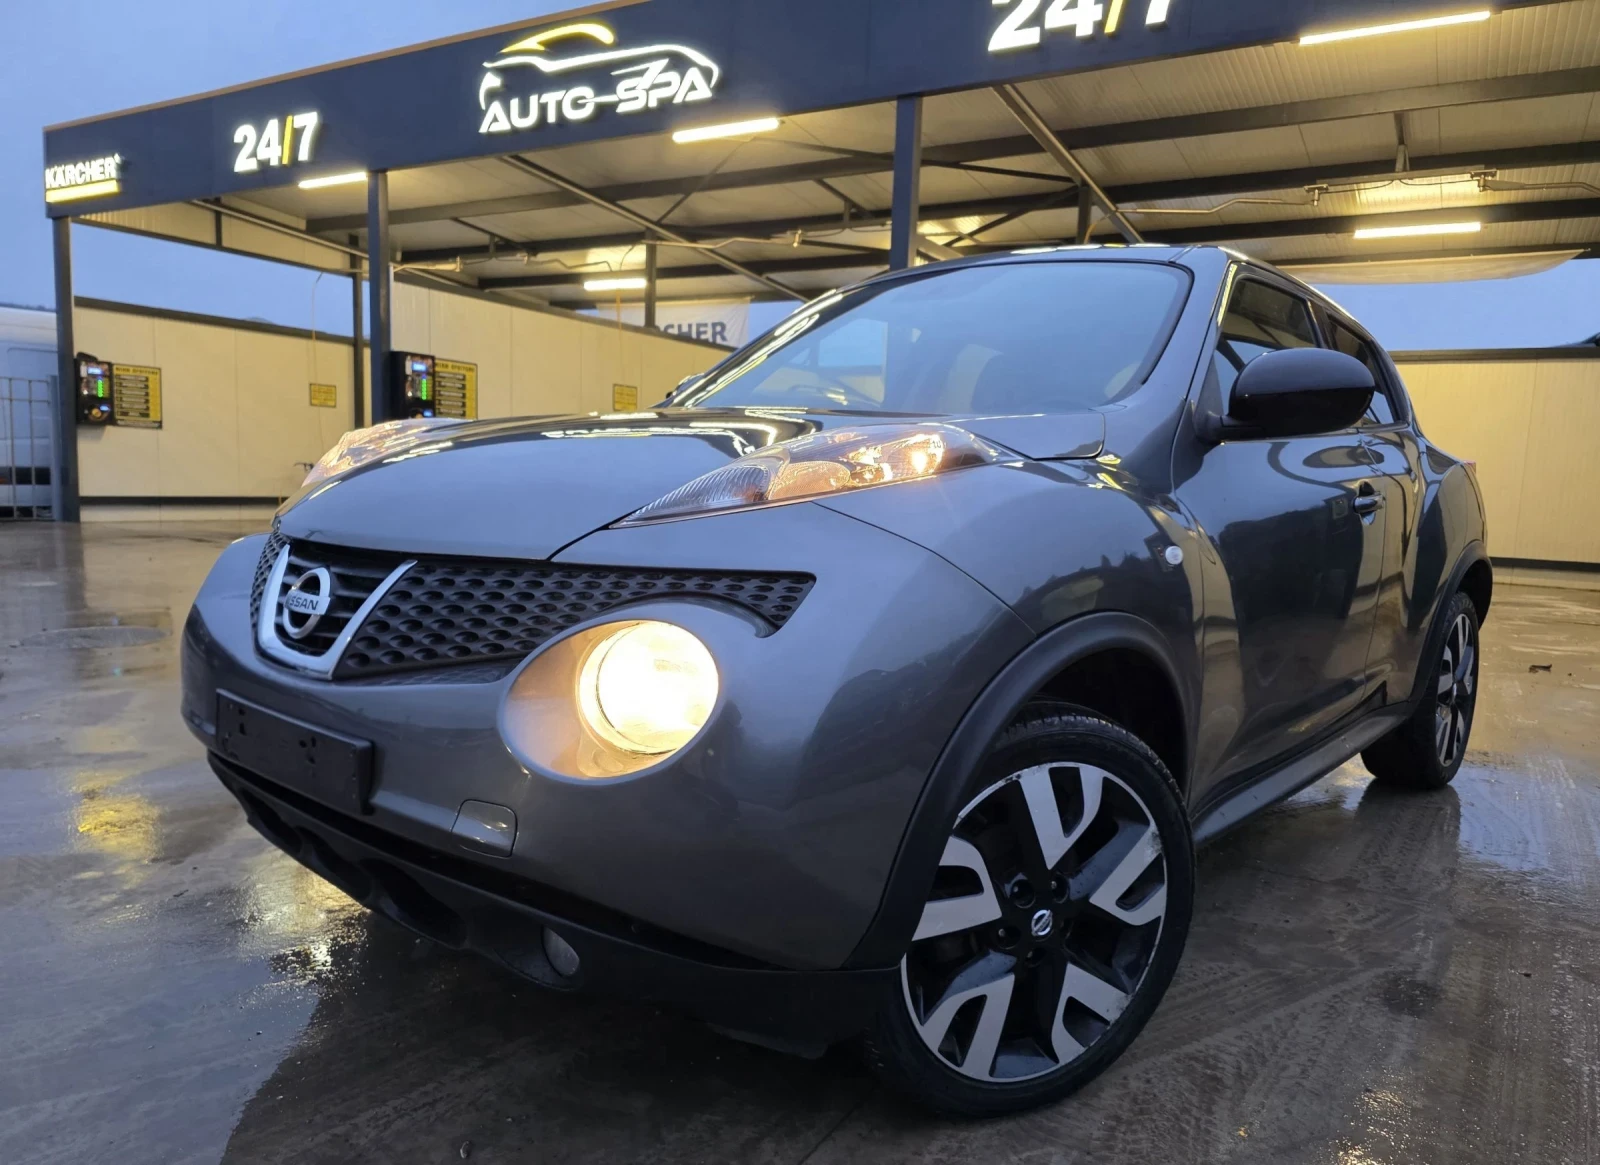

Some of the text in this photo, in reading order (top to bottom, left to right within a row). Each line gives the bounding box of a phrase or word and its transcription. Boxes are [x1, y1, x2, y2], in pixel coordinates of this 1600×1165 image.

[479, 60, 713, 133] AUTO SPA
[234, 111, 318, 172] 24/7
[661, 321, 728, 343] CHER
[289, 596, 319, 611] SSAN
